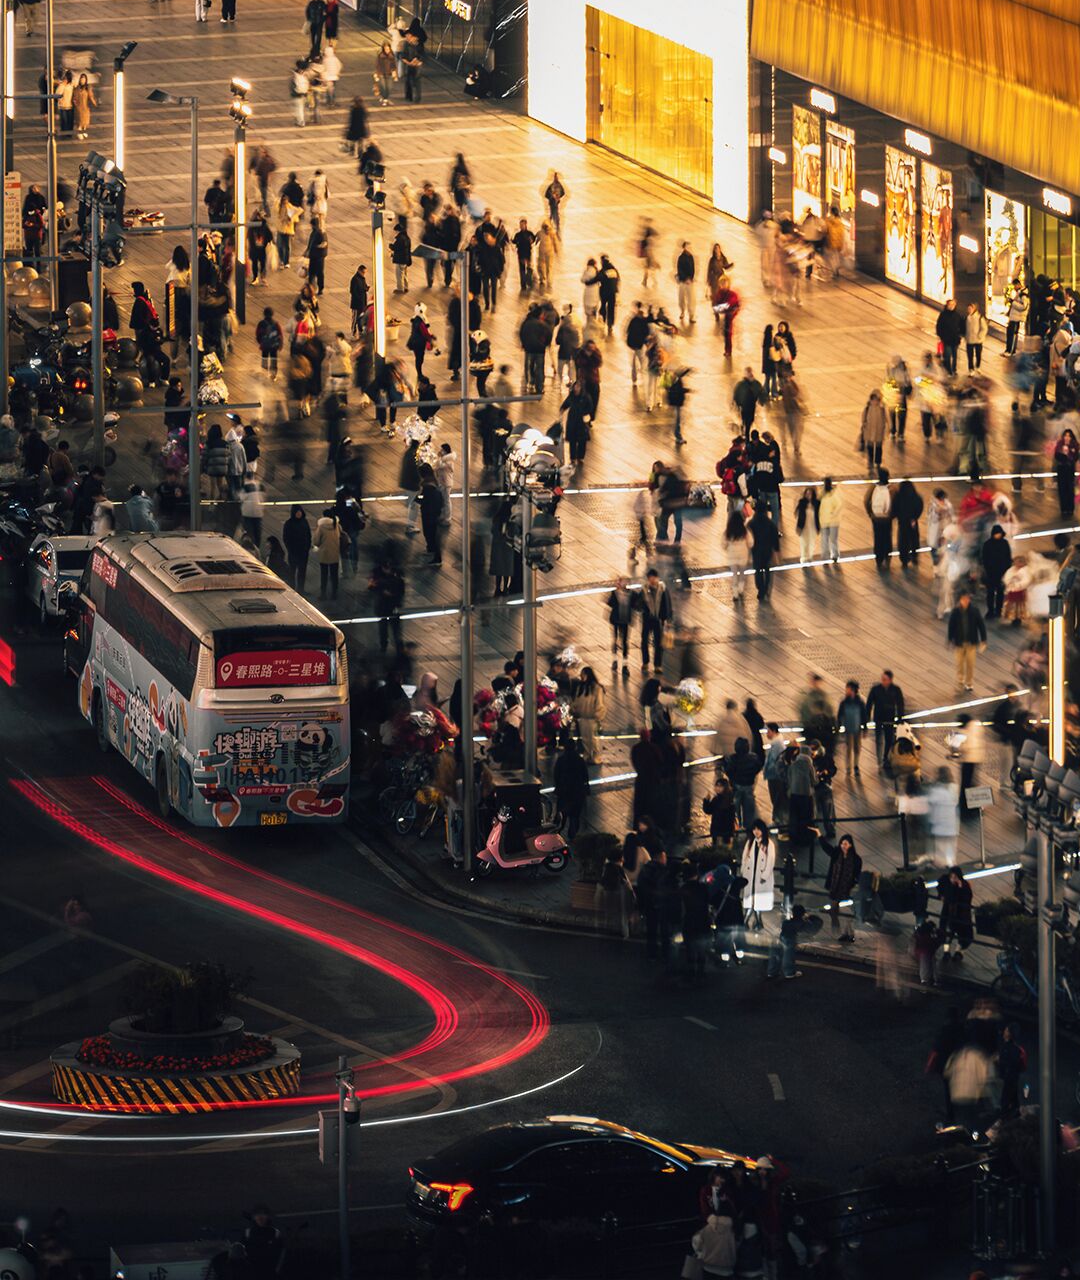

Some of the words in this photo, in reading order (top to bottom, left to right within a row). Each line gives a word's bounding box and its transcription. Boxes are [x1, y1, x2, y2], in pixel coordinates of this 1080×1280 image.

[236, 664, 273, 679] 春熙路
[288, 662, 326, 677] 三星堆
